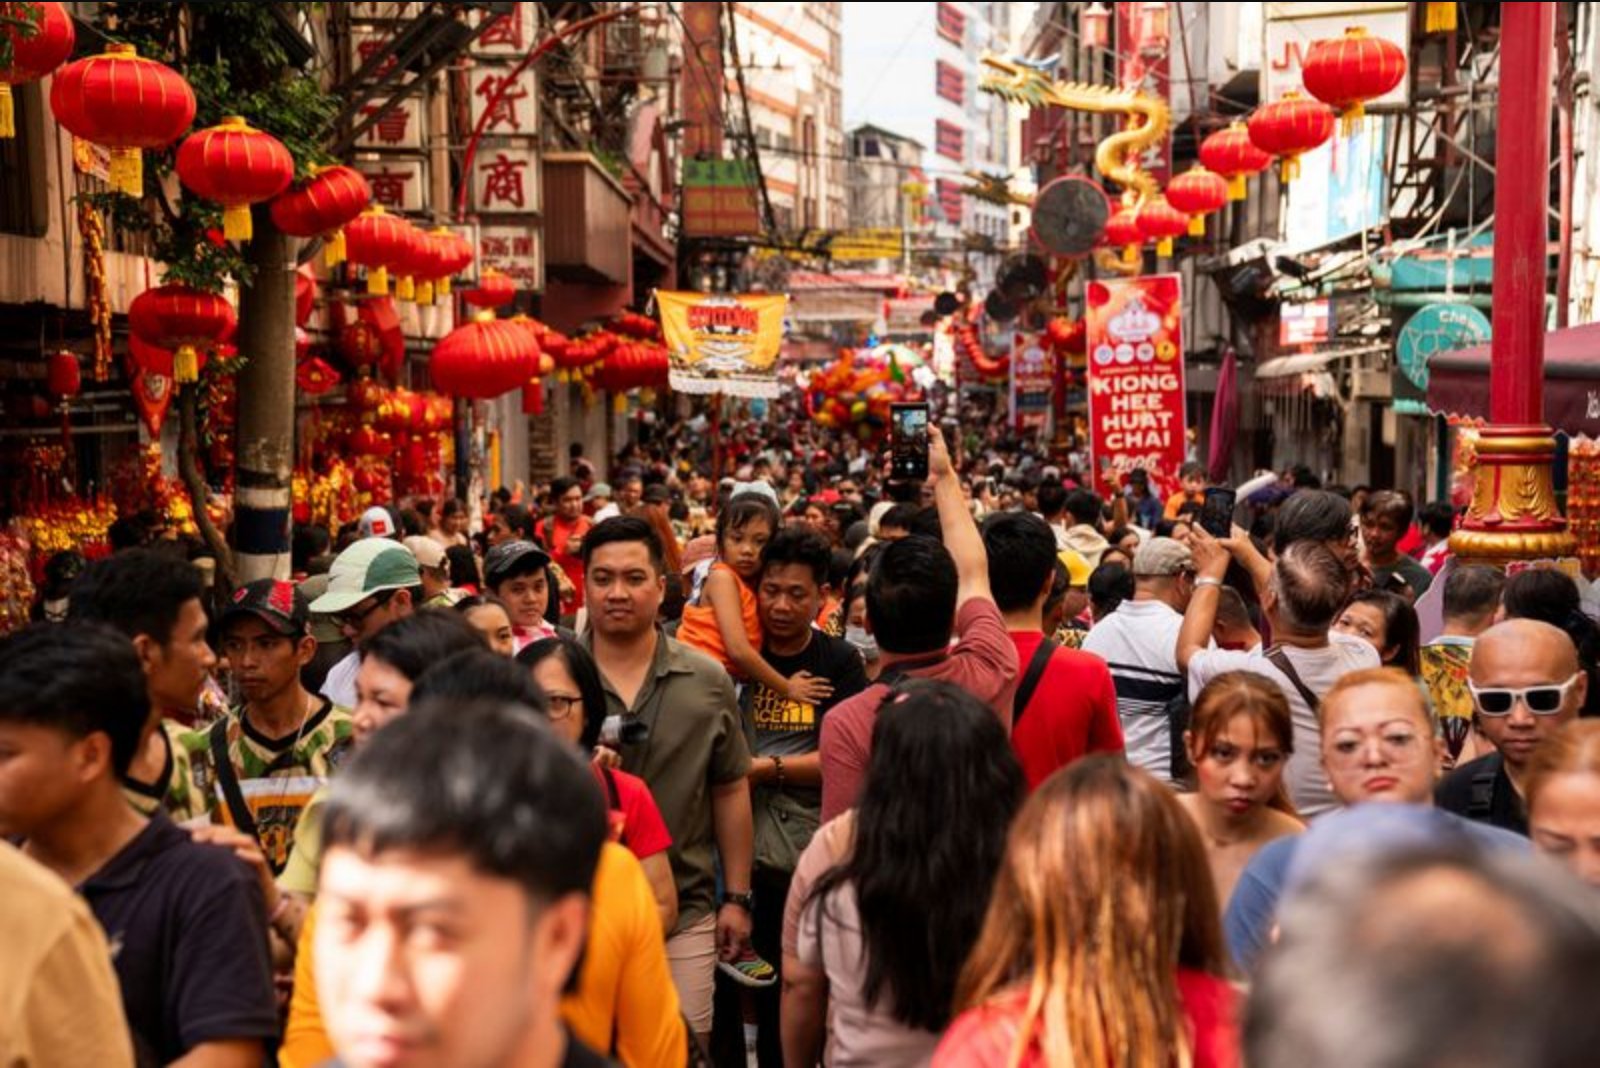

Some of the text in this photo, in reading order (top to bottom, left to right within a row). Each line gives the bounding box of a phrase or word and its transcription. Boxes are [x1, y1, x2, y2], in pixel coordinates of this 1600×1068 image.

[1093, 373, 1178, 395] KIONG
[1112, 393, 1163, 412] HEE
[1102, 410, 1173, 431] HUAT
[1105, 430, 1171, 450] CHAI
